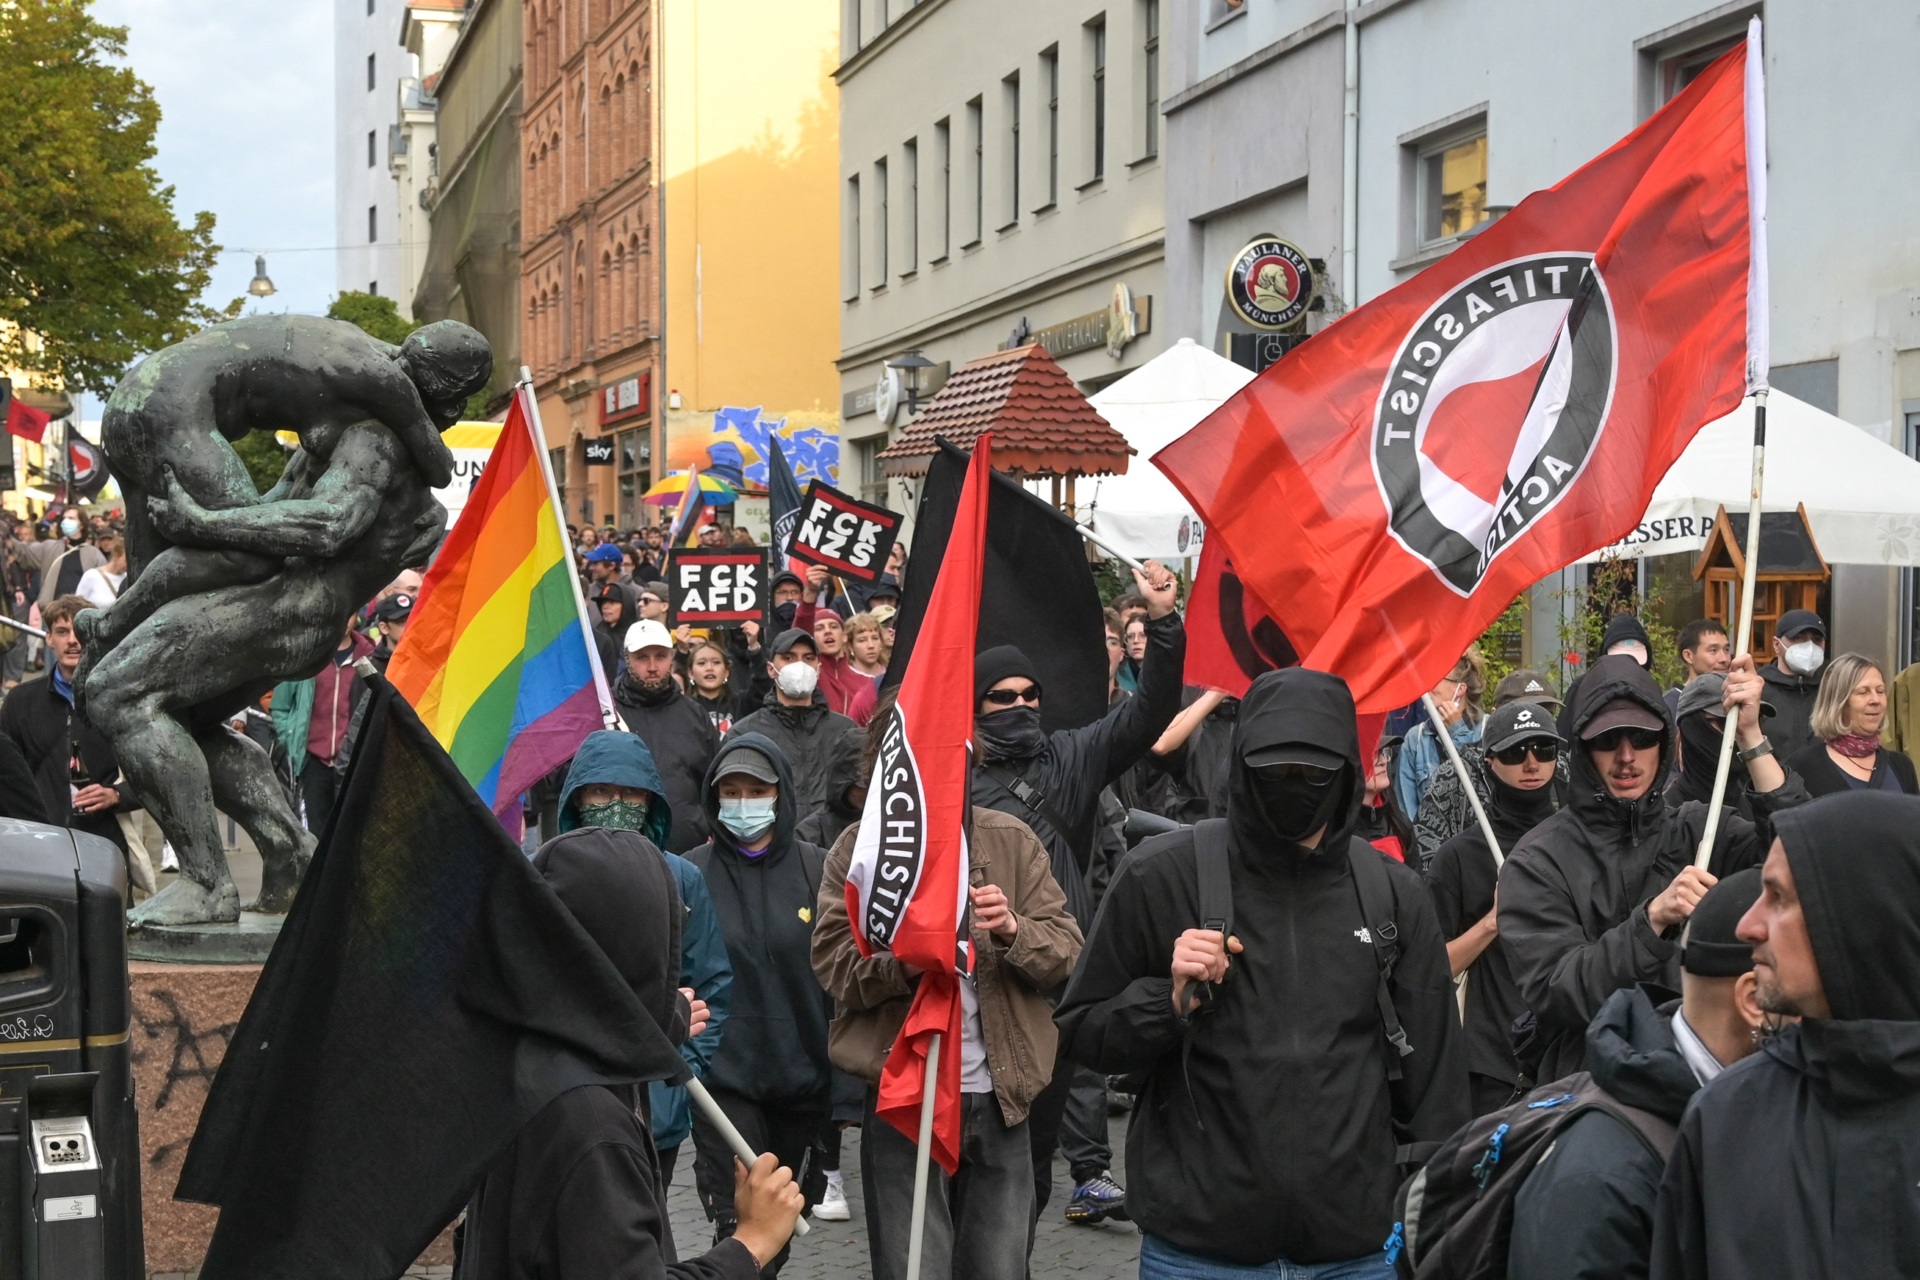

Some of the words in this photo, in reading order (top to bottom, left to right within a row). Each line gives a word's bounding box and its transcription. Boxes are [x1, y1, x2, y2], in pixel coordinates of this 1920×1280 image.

[1236, 243, 1307, 274] PAULANER
[1242, 301, 1302, 323] MÜNCHEN
[586, 444, 611, 460] sky
[809, 498, 883, 545] FCK
[797, 519, 876, 568] NZS
[680, 564, 758, 588] FCK
[681, 586, 756, 612] AFD
